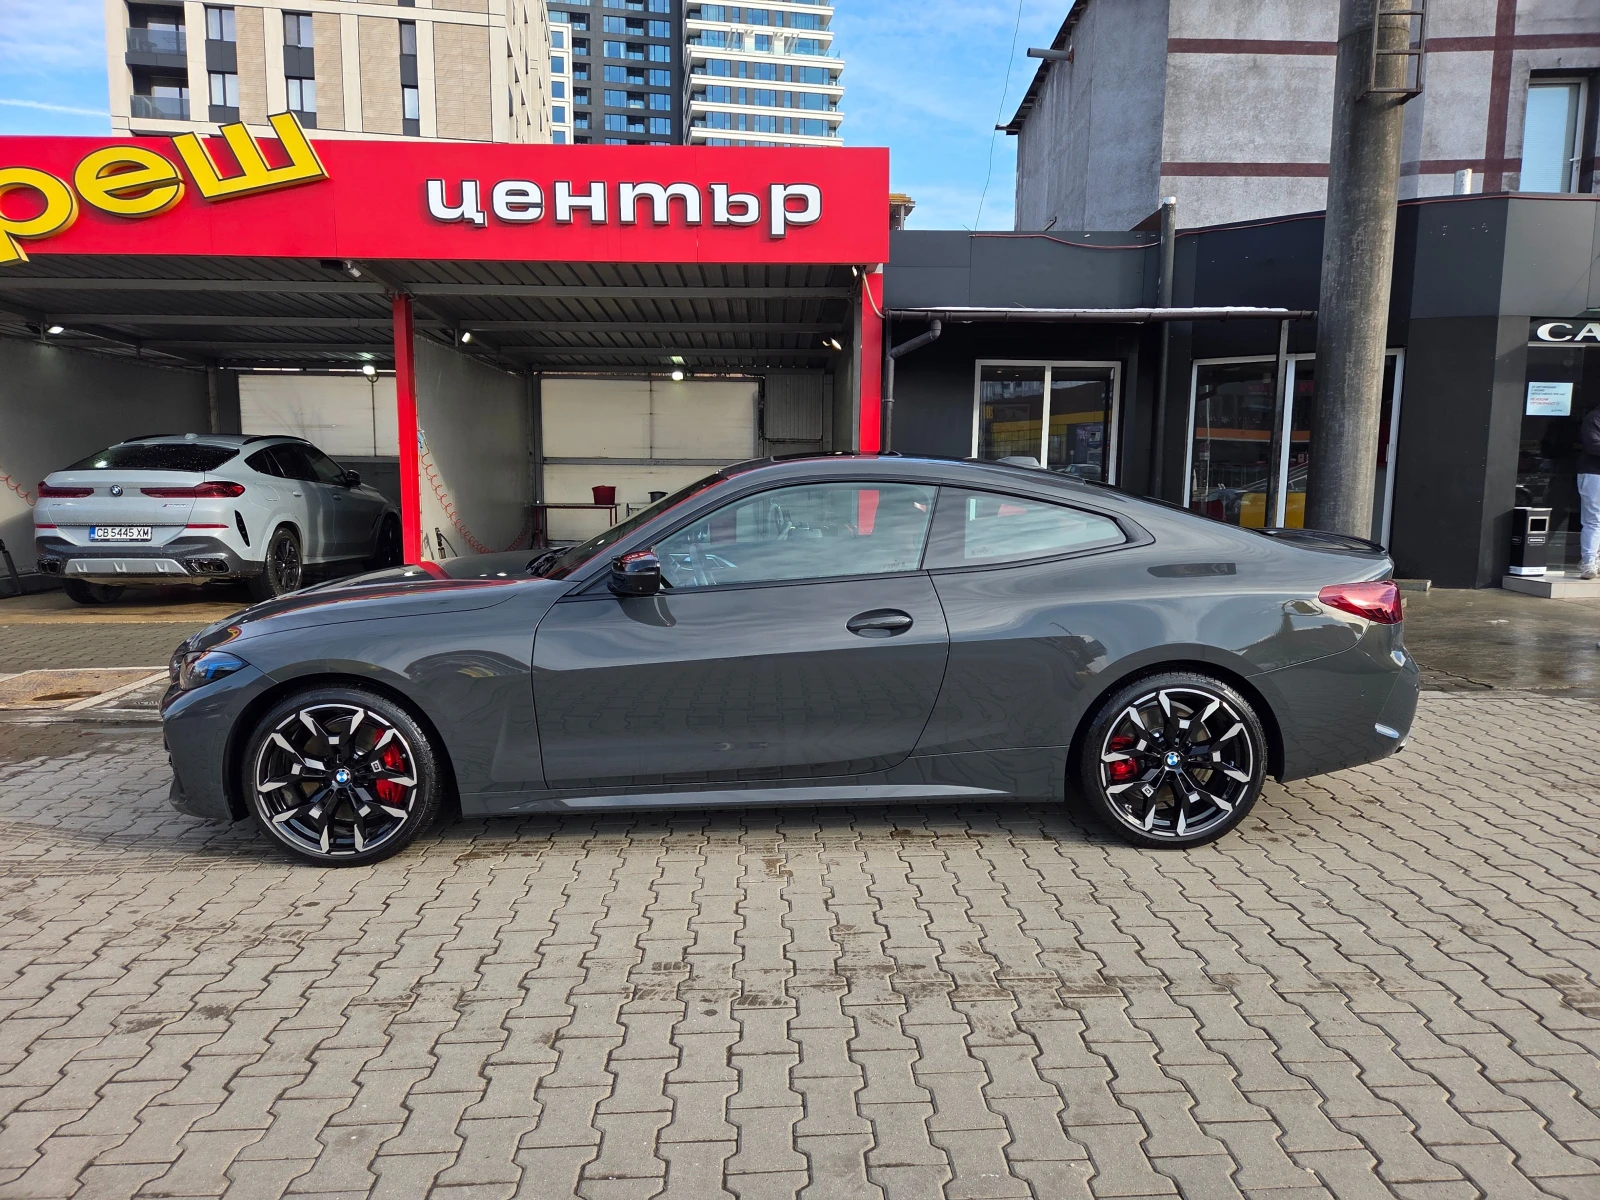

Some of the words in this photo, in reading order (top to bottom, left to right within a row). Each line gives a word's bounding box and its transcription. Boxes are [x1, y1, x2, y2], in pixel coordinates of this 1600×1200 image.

[425, 178, 823, 239] център
[1536, 322, 1600, 342] CA
[96, 527, 109, 538] CB
[110, 527, 135, 538] 5445
[136, 527, 150, 538] XM
